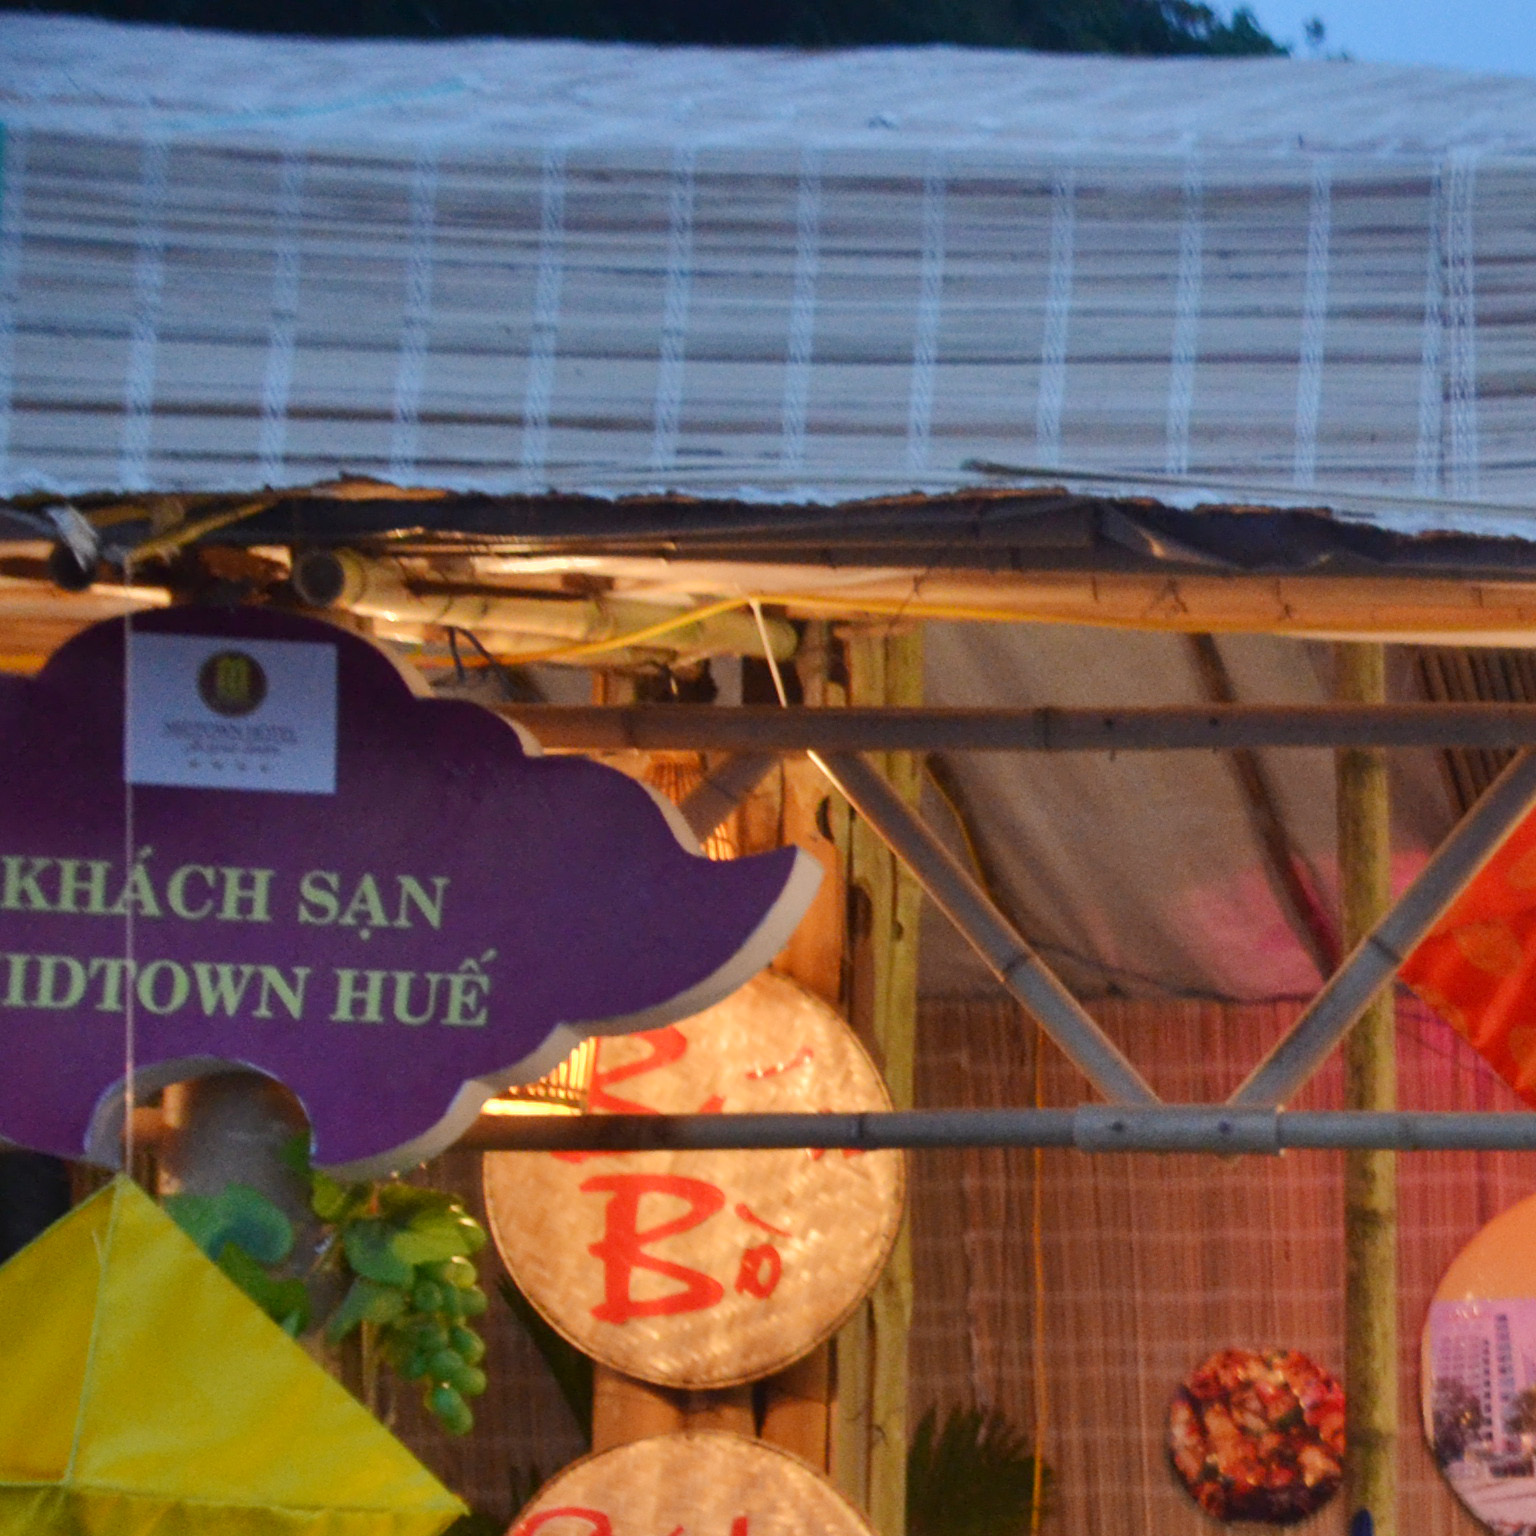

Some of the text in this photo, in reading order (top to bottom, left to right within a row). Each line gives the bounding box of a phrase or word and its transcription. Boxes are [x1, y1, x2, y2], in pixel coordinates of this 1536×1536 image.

[1, 845, 451, 941] KHÁCH SẠN
[0, 948, 498, 1028] IDTOWN HUẾ
[579, 1173, 794, 1325] Bò
